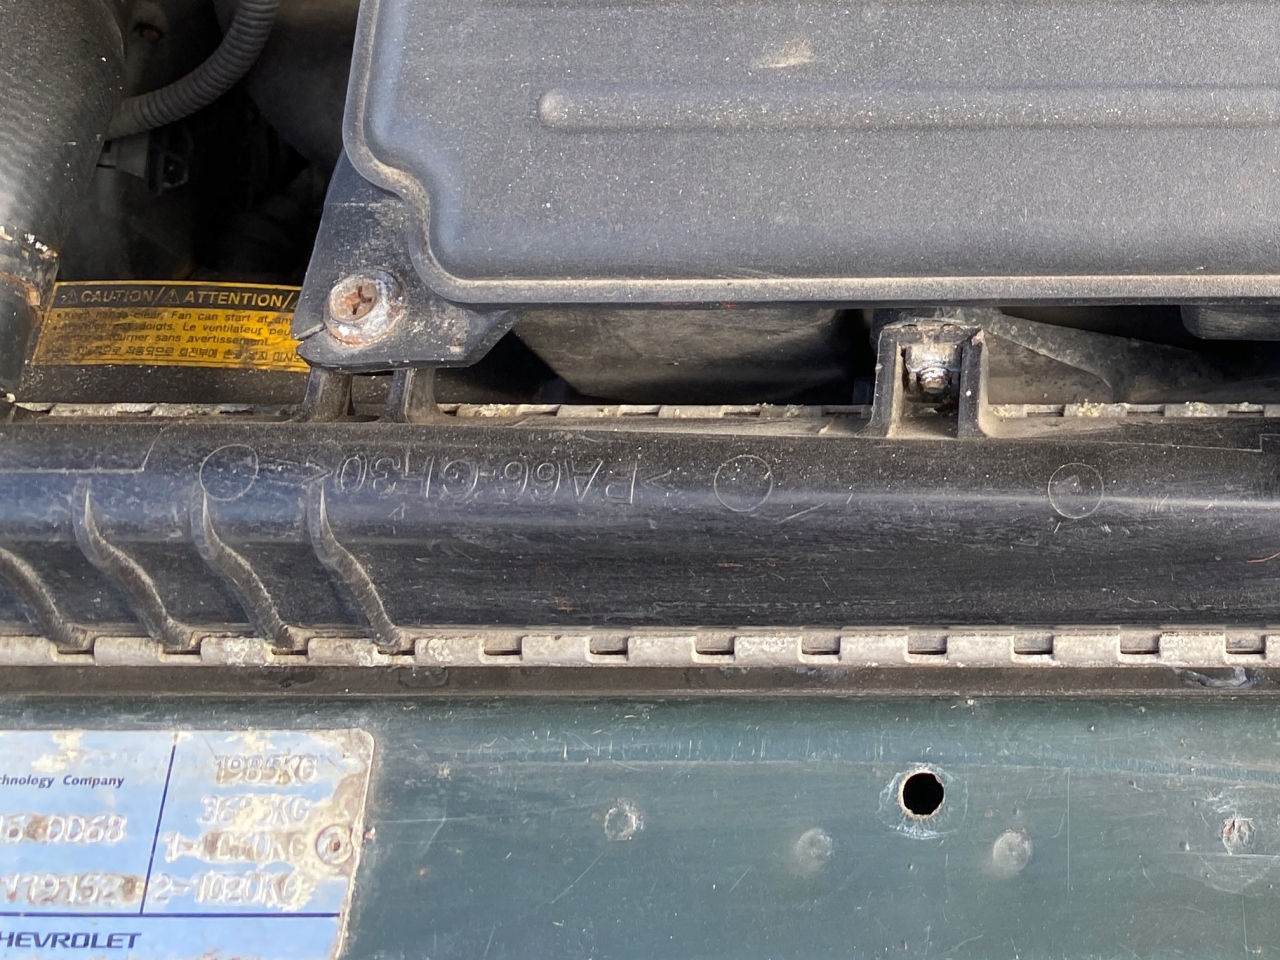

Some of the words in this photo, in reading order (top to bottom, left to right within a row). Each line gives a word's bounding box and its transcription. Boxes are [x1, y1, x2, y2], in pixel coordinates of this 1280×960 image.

[171, 310, 191, 320] Fan
[198, 313, 218, 321] can
[225, 313, 251, 322] start
[271, 316, 292, 325] an
[183, 323, 197, 332] Le
[269, 328, 291, 337] peu
[155, 335, 182, 343] sans
[0, 774, 55, 788] hnology
[62, 775, 125, 789] Company
[0, 931, 142, 949] HEVROLET
